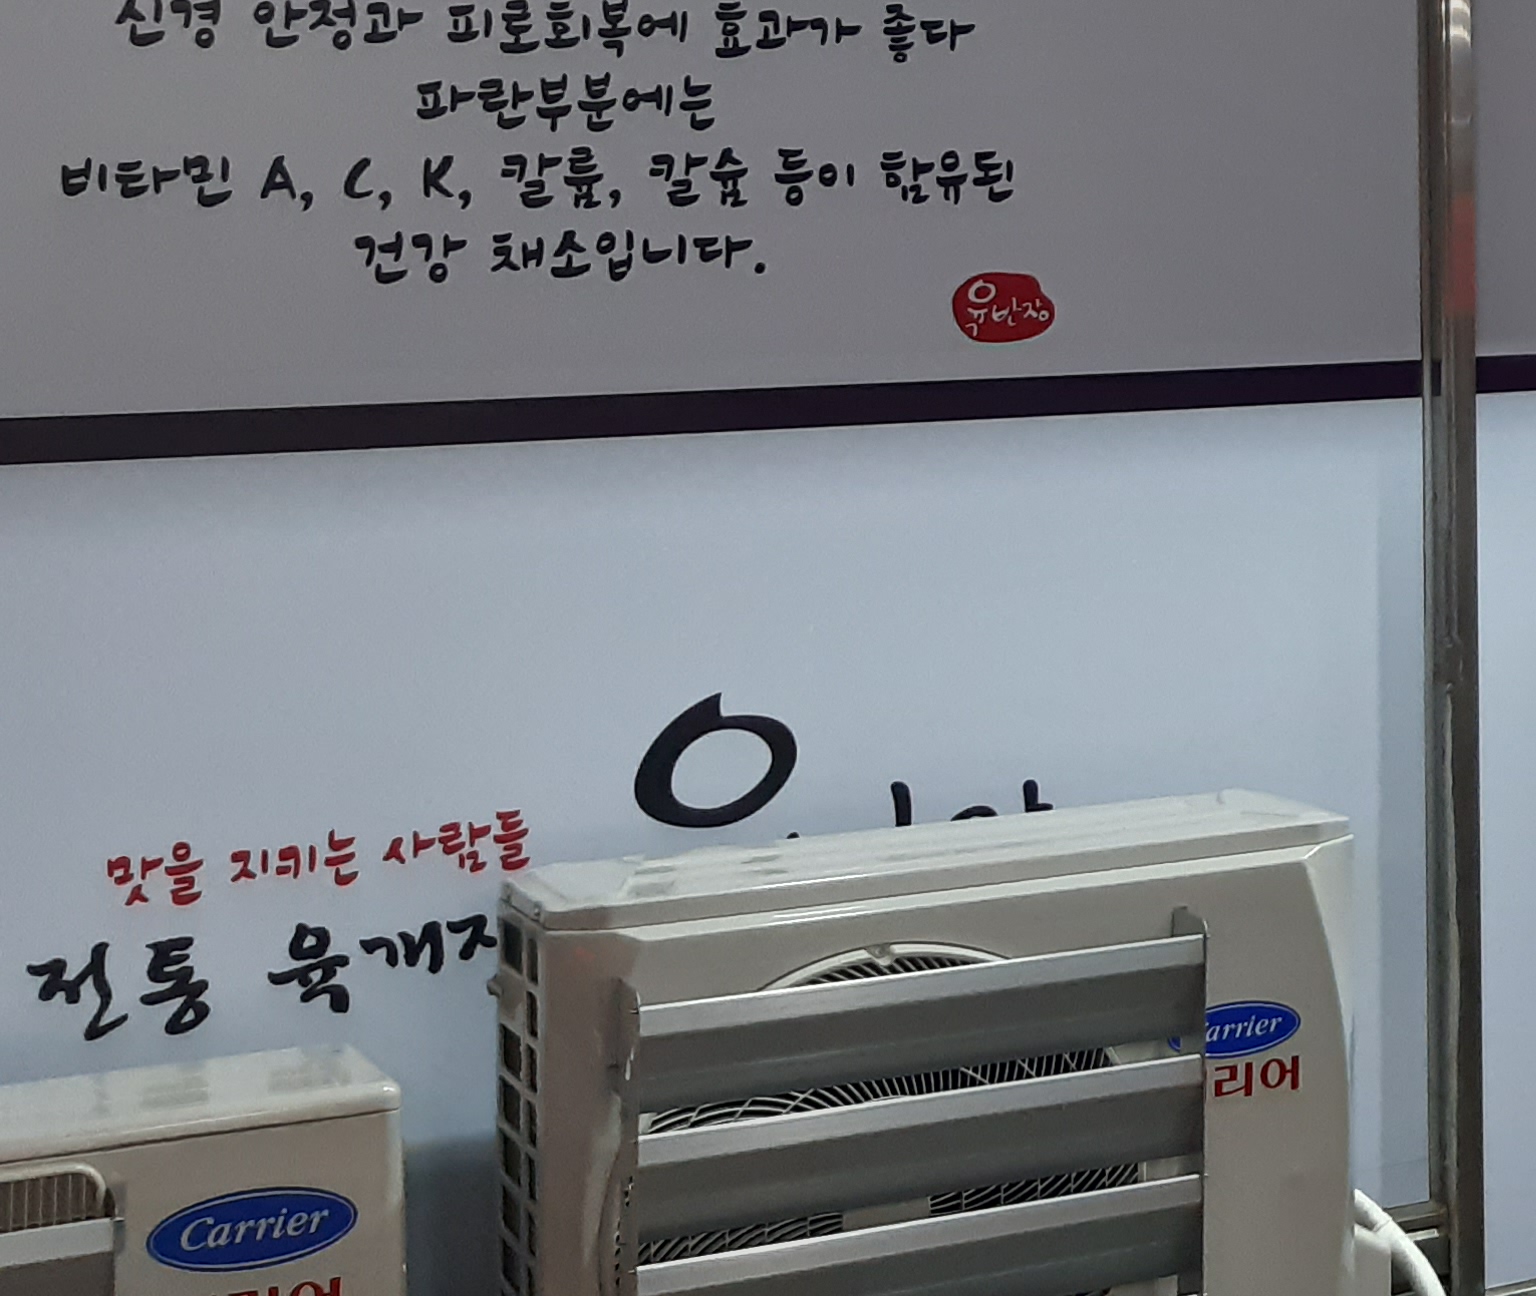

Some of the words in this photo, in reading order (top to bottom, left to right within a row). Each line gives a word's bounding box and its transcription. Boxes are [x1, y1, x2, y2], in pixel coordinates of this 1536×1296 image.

[714, 1, 863, 59] 효과가
[882, 3, 976, 64] 좋다
[416, 71, 715, 133] 파란부분에는
[60, 154, 233, 208] 비타민
[260, 155, 314, 212] A,
[343, 157, 392, 211] C,
[422, 155, 472, 210] K,
[500, 146, 621, 210] 칼륨,
[648, 146, 749, 208] 칼슘
[774, 148, 855, 207] 등이
[879, 150, 1014, 206] 함유된
[354, 230, 468, 285] 건강
[490, 229, 766, 283] 채소입니다.
[966, 277, 1051, 338] 육반장
[107, 855, 202, 907] 맛을
[230, 832, 357, 889] 지키는
[384, 811, 529, 875] 사람들
[26, 936, 211, 1042] 전통
[1204, 1015, 1283, 1043] arrier
[1204, 1055, 1299, 1098] 리어
[179, 1207, 330, 1253] Carrier
